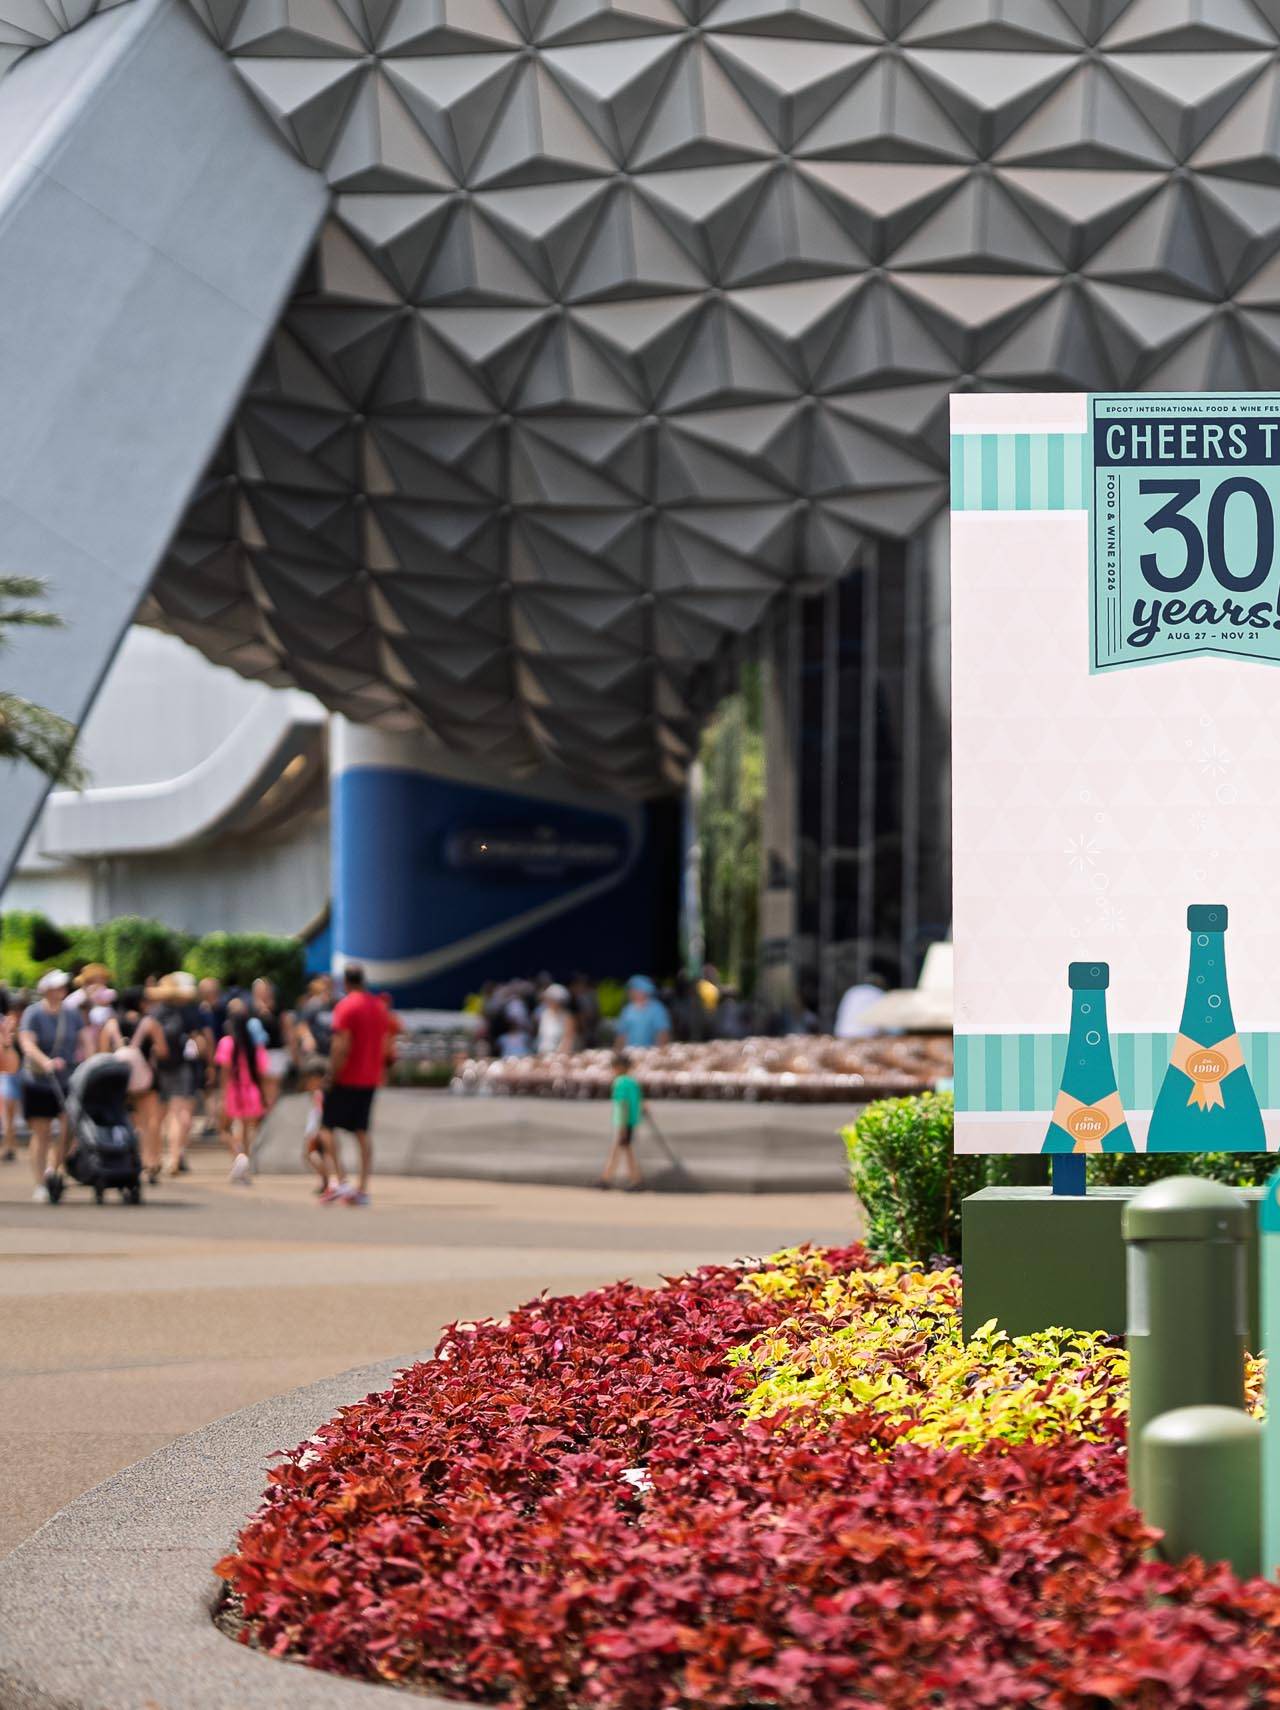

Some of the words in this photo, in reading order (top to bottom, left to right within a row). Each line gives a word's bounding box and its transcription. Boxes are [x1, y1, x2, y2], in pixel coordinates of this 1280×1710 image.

[1106, 424, 1248, 460] CHEERS
[1106, 475, 1115, 508] FOOD
[1107, 513, 1115, 521] &
[1107, 525, 1116, 558] WINE
[1139, 476, 1275, 593] 30
[1107, 562, 1116, 591] 2026
[1167, 632, 1191, 640] AUG
[1194, 632, 1207, 640] 27
[1221, 631, 1244, 640] NOV
[1248, 631, 1259, 640] 21
